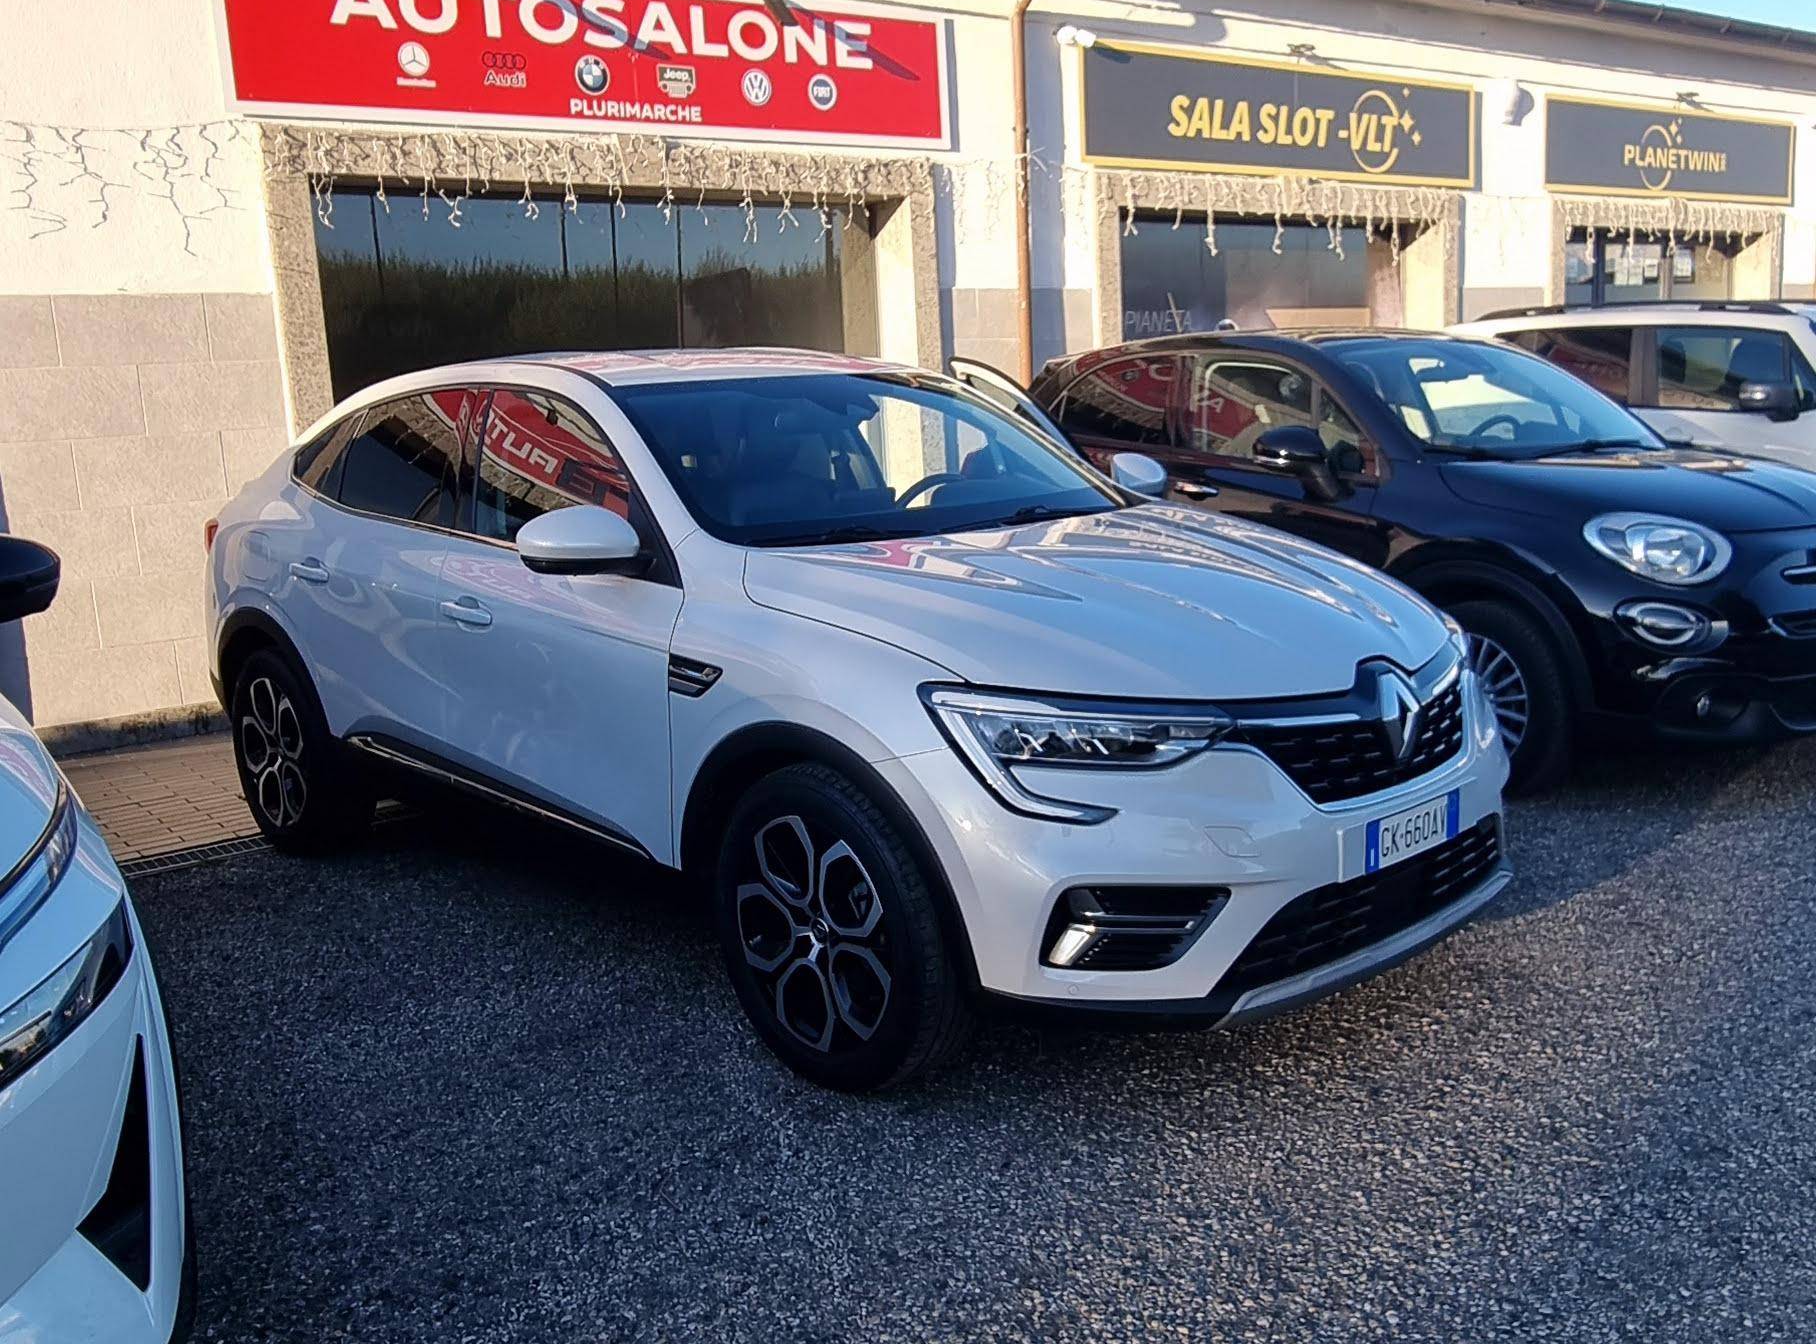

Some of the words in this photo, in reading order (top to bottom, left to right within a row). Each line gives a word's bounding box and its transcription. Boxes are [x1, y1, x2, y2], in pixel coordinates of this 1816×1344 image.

[484, 70, 527, 88] Audi
[569, 97, 702, 123] PLURIMARCHE
[1167, 94, 1250, 142] SALA
[1256, 102, 1335, 148] SLOT
